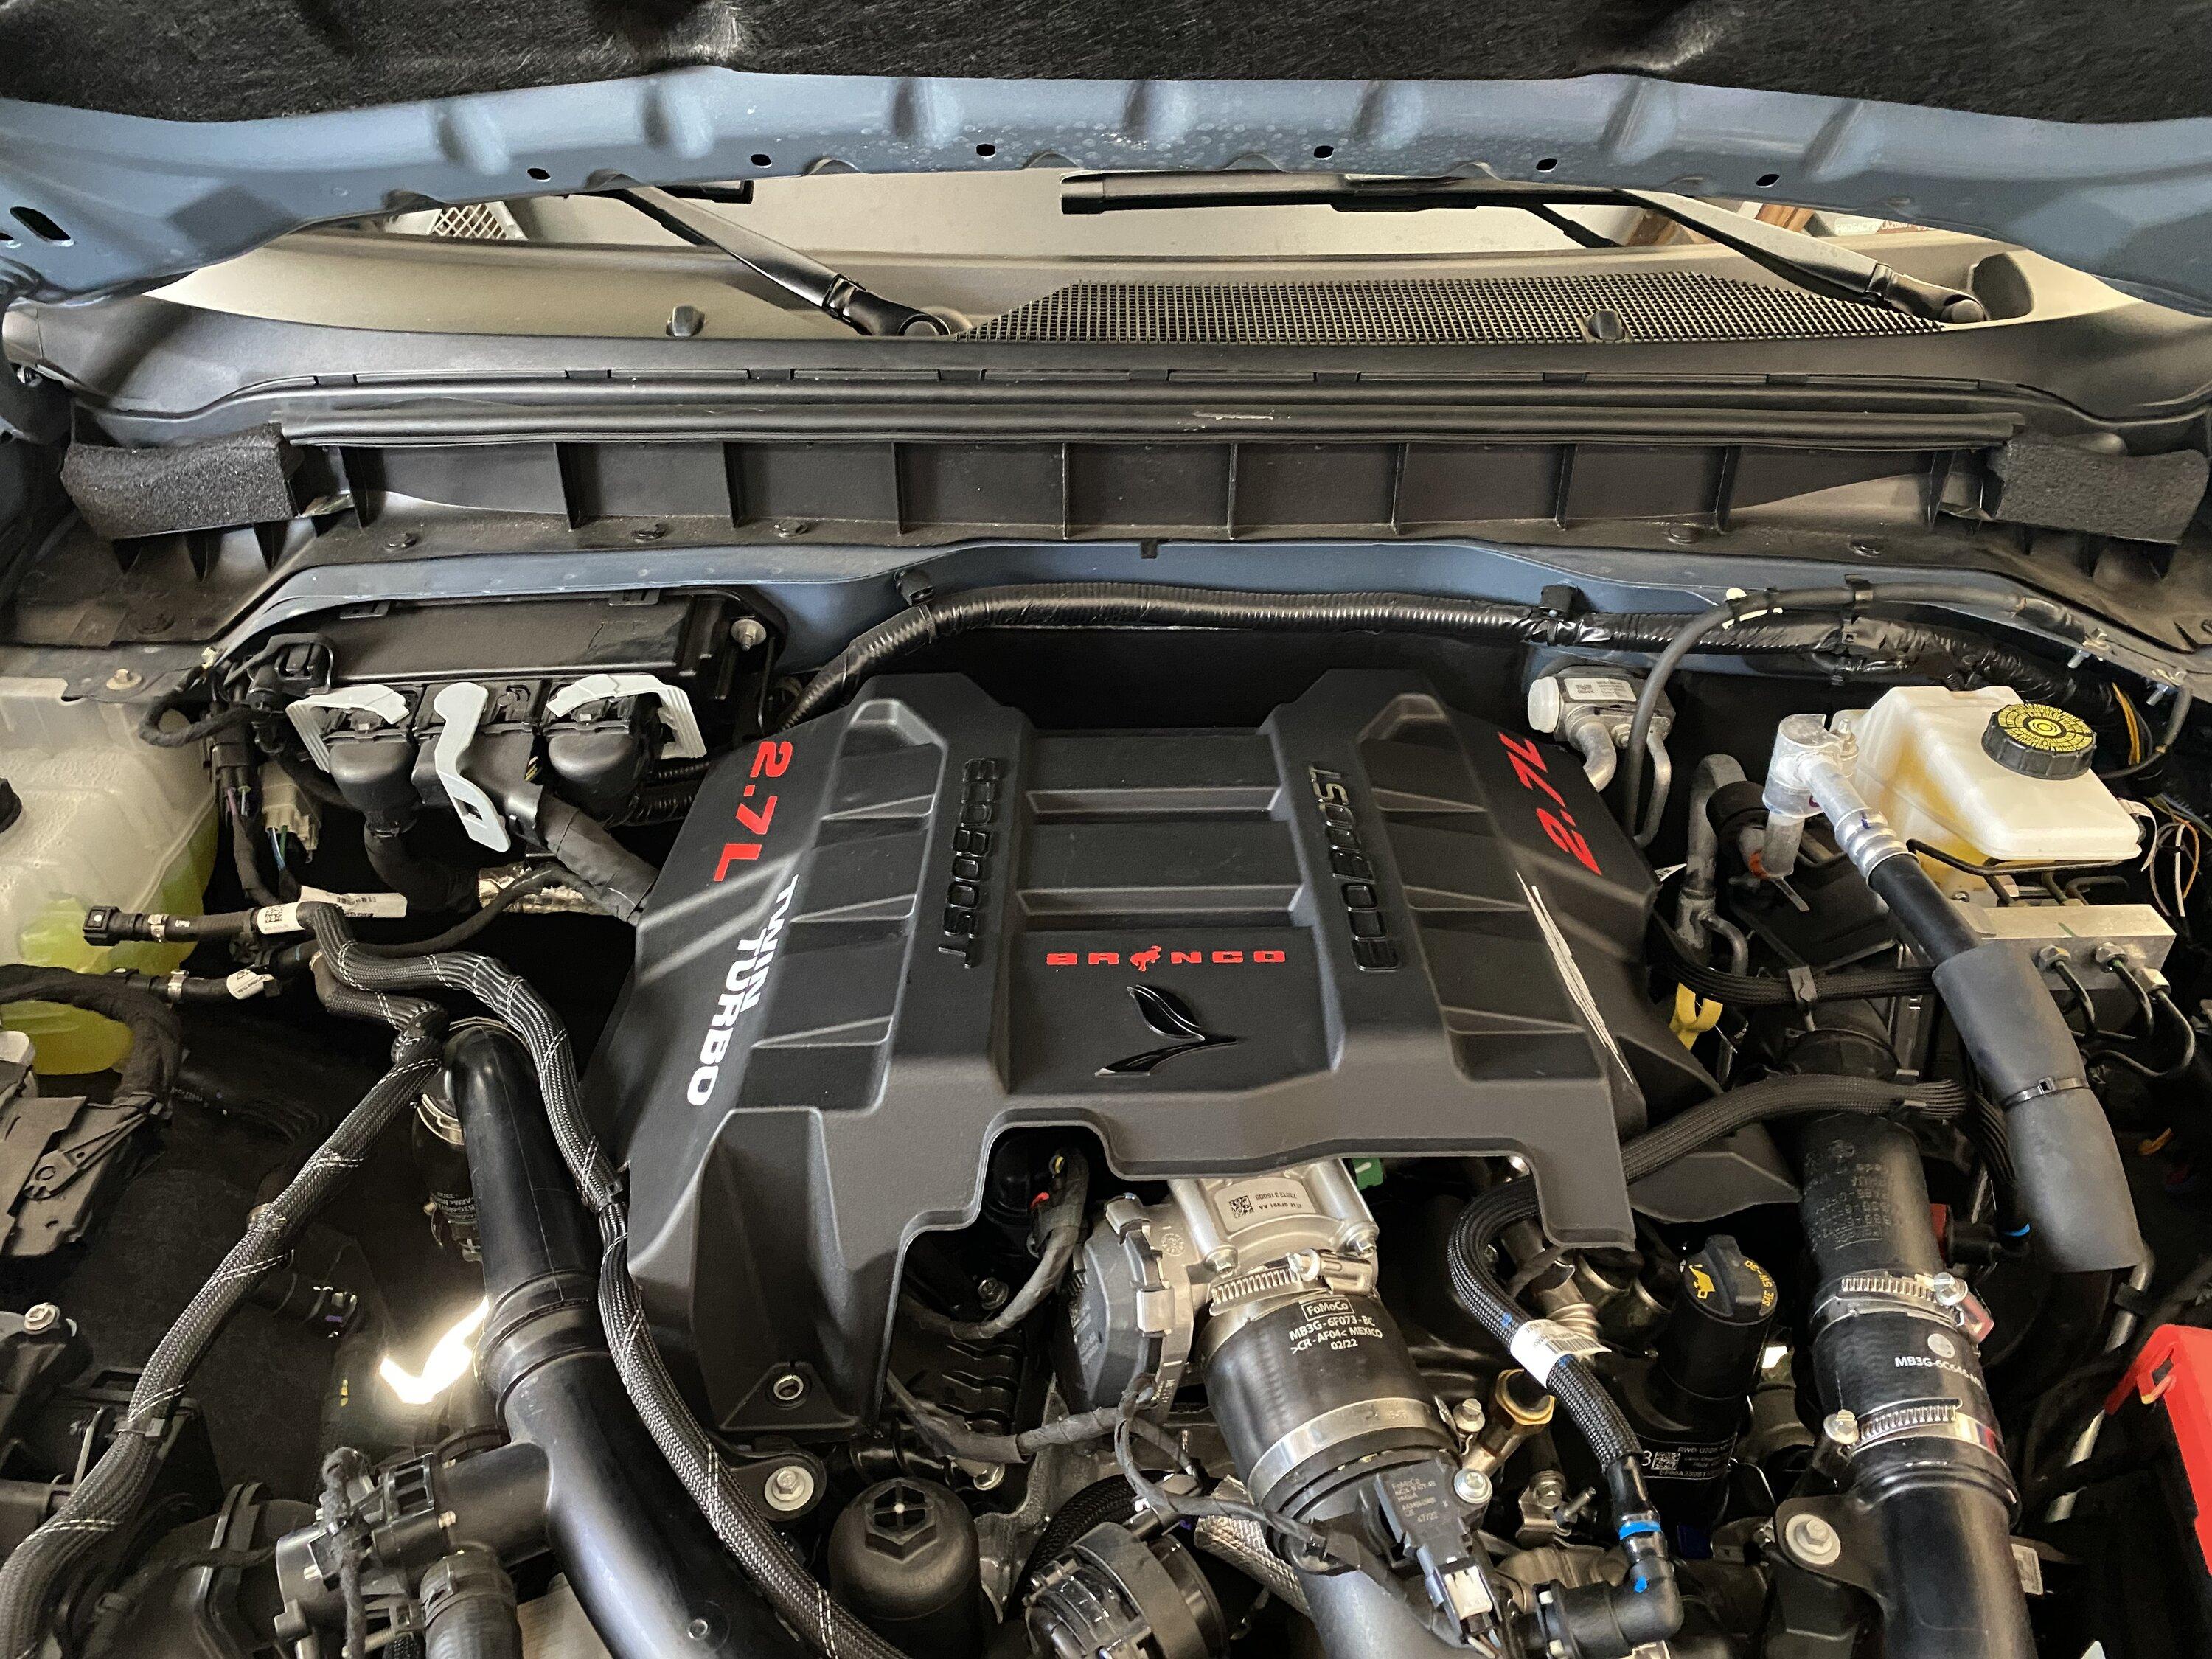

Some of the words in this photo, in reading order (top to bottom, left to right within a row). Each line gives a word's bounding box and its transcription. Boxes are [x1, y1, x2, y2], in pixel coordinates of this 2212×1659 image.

[714, 740, 793, 883] 2.7L
[1498, 732, 1603, 876] 2.7L
[938, 757, 997, 970] ECOBOOST
[1309, 764, 1399, 973] ECOBOOST
[740, 874, 799, 1013] TWIN
[1046, 947, 1286, 970] BRNCO
[687, 928, 768, 1106] TURBO
[1306, 1301, 1349, 1315] FoMoCo
[1745, 1259, 1773, 1288] 5W-30
[1761, 1290, 1775, 1307] SAE
[1330, 1338, 1358, 1351] 02/22
[1348, 1326, 1383, 1338] MEXICO
